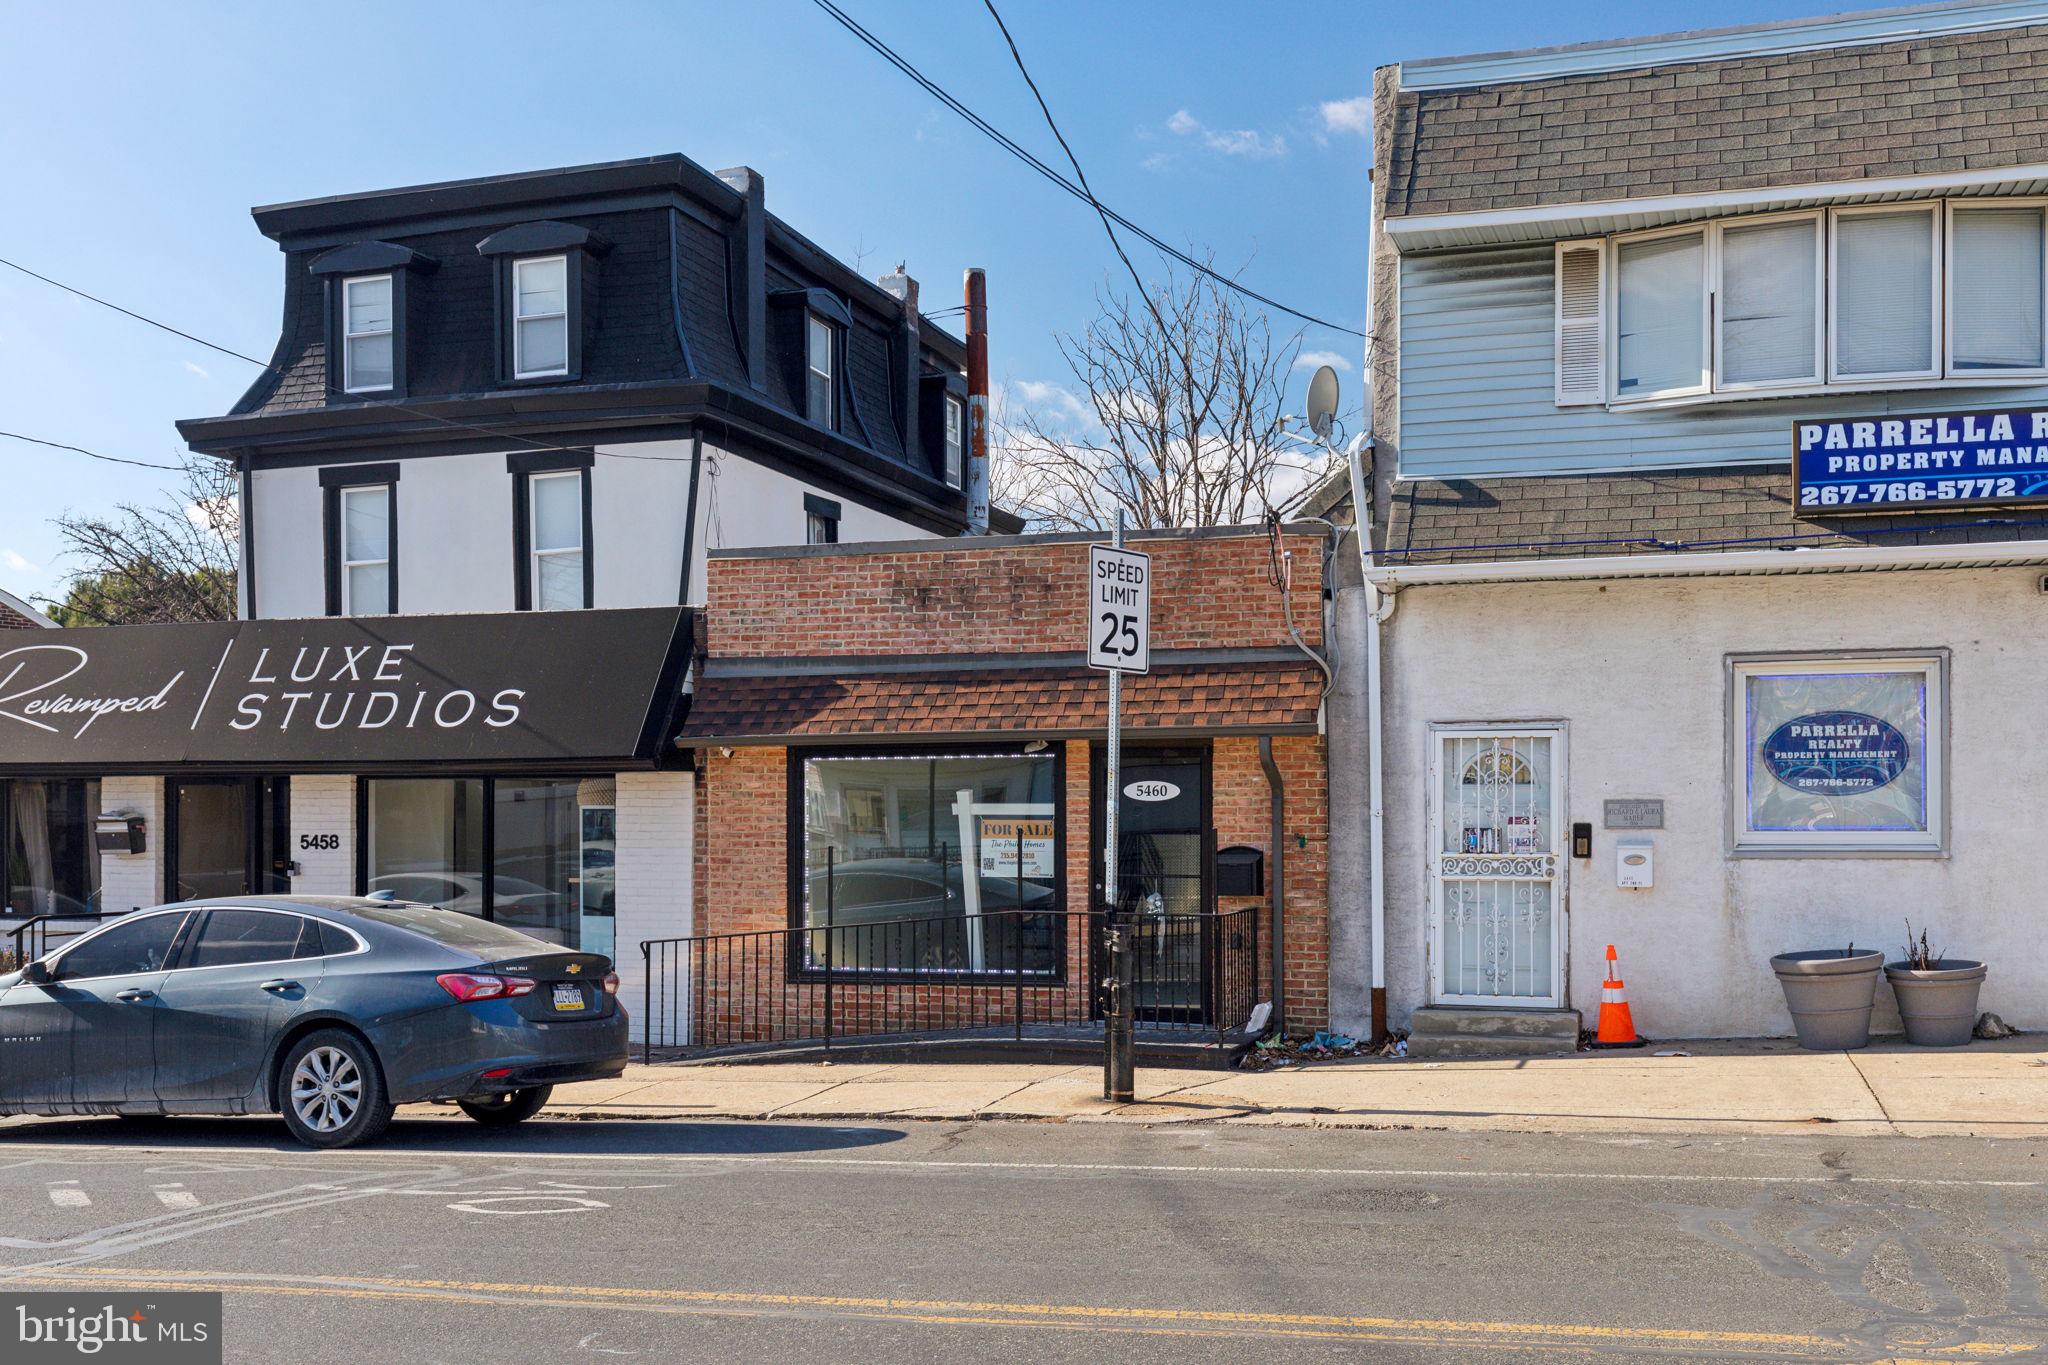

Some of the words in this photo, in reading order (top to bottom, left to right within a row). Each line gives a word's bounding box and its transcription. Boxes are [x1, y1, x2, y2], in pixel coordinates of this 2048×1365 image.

[1800, 414, 2014, 450] PARRELLA
[1828, 450, 1964, 473] PROPERTY
[1801, 478, 2016, 506] 267-766-5772
[1097, 560, 1144, 585] SPEED
[1101, 584, 1139, 607] LIMIT
[1100, 612, 1139, 657] 25
[249, 643, 414, 683] LUXE
[0, 645, 184, 739] Revamped
[229, 689, 526, 730] STUDIOS
[1791, 724, 1879, 737] PARRELLA
[1808, 739, 1862, 749] REALTY
[1829, 750, 1897, 759] MANAGEMENT
[1136, 785, 1168, 797] 5460
[1798, 778, 1874, 787] 267-766-5772
[984, 824, 1012, 836] FOR
[300, 834, 340, 850] 5458
[991, 840, 1002, 849] The
[1024, 840, 1046, 849] Homes
